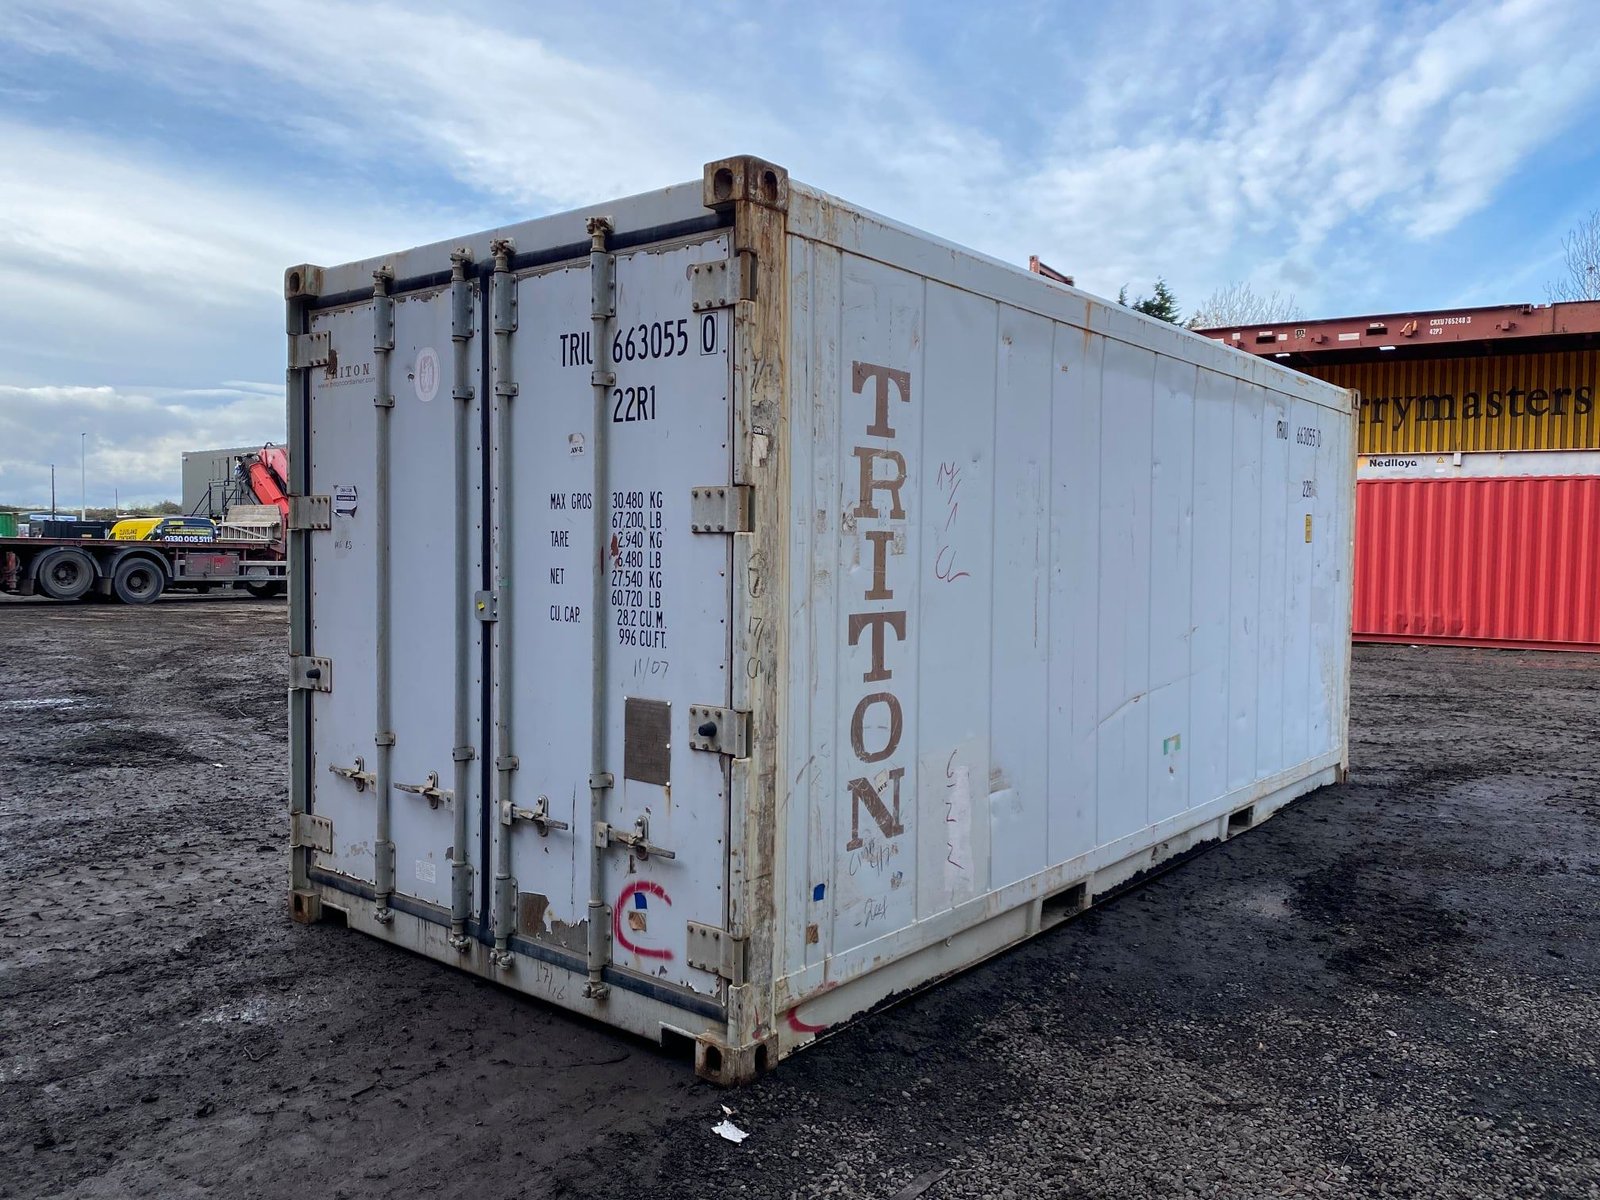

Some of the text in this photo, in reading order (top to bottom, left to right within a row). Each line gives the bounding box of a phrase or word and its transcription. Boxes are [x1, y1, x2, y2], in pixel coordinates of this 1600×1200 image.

[612, 319, 688, 364] 663055
[702, 314, 716, 353] 0
[612, 385, 656, 423] 22R1
[550, 491, 663, 510] MAX GROS 30.480 KG
[612, 511, 662, 529] 67.200 LB
[550, 530, 663, 549] TARE 2.940 KG
[649, 551, 662, 569] LB
[550, 567, 662, 589] NET 27.540 KG
[611, 590, 661, 609] 60.720 LB
[847, 359, 911, 853] TRITON
[617, 609, 637, 627] 28.2
[618, 628, 637, 646] 996
